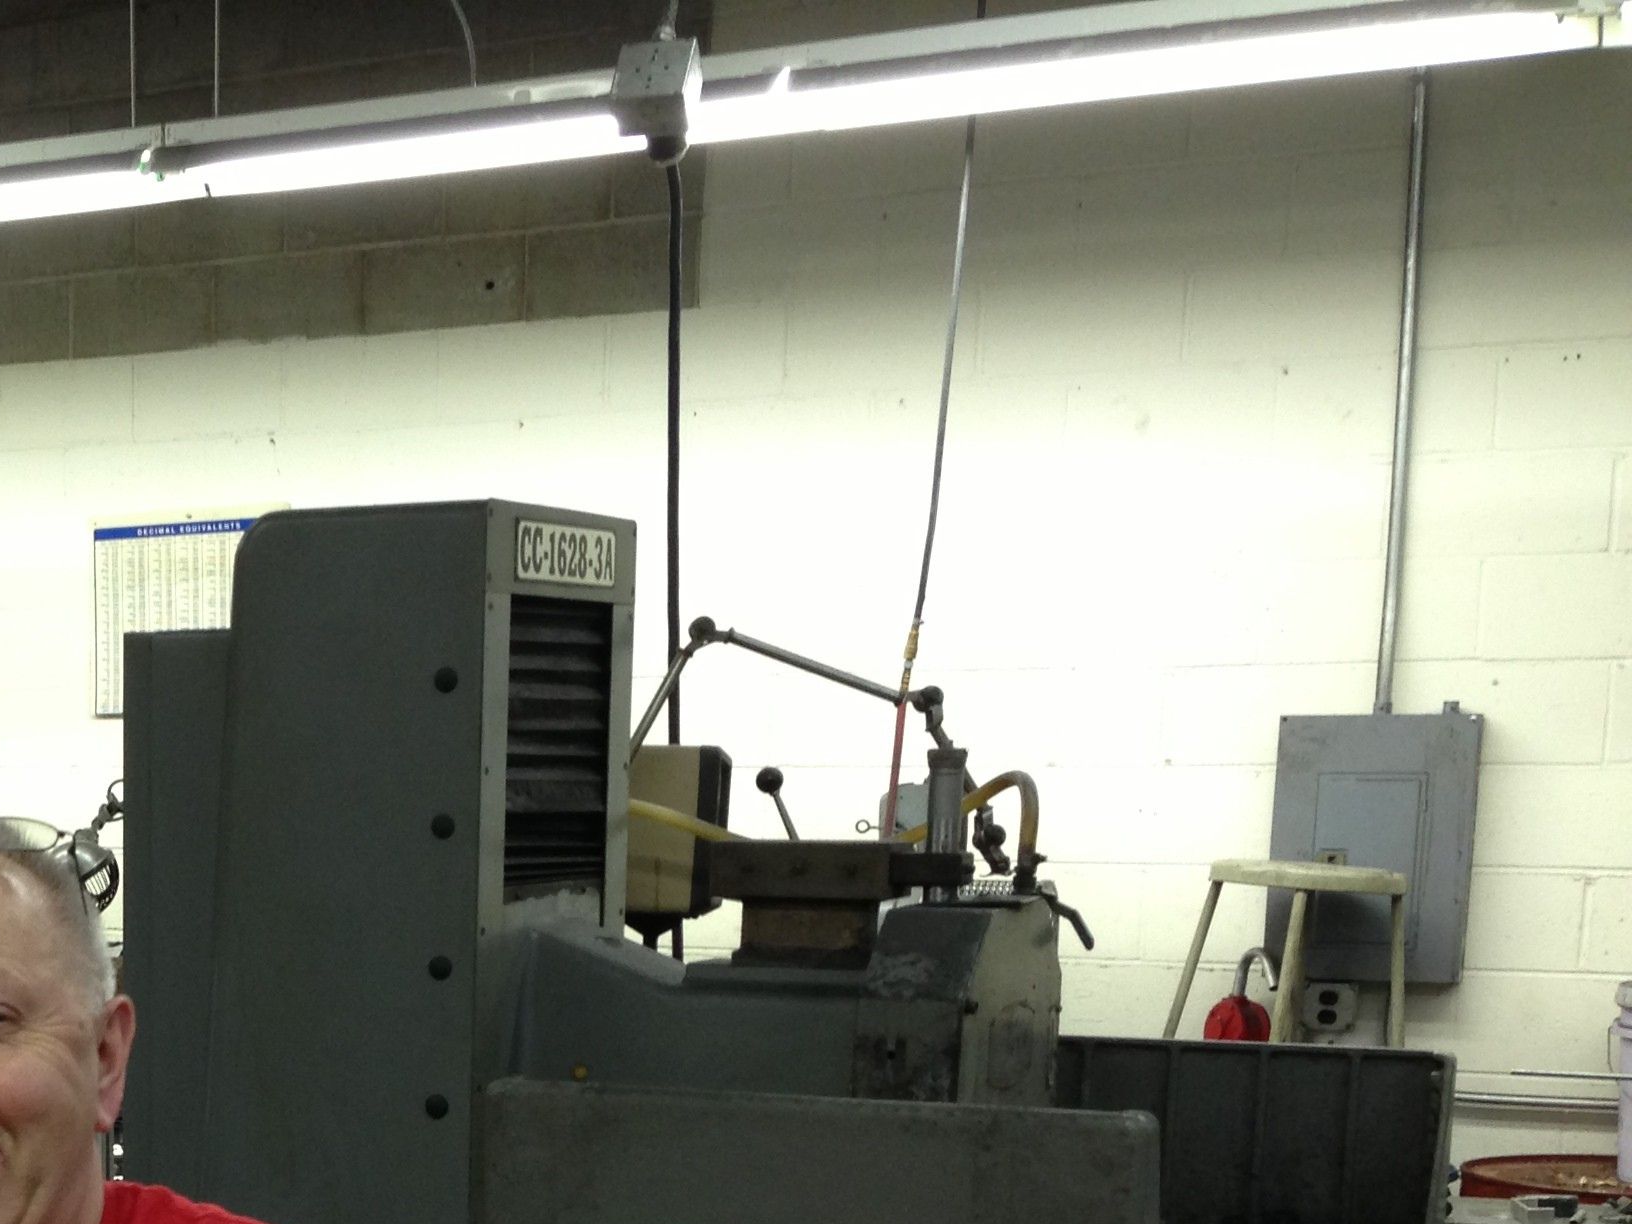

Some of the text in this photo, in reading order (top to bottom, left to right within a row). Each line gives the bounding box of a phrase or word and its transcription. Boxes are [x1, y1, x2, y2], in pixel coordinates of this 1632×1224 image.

[137, 522, 241, 536] DECIMAL EQUIVALENTS
[519, 524, 613, 580] CC-1628-3A
